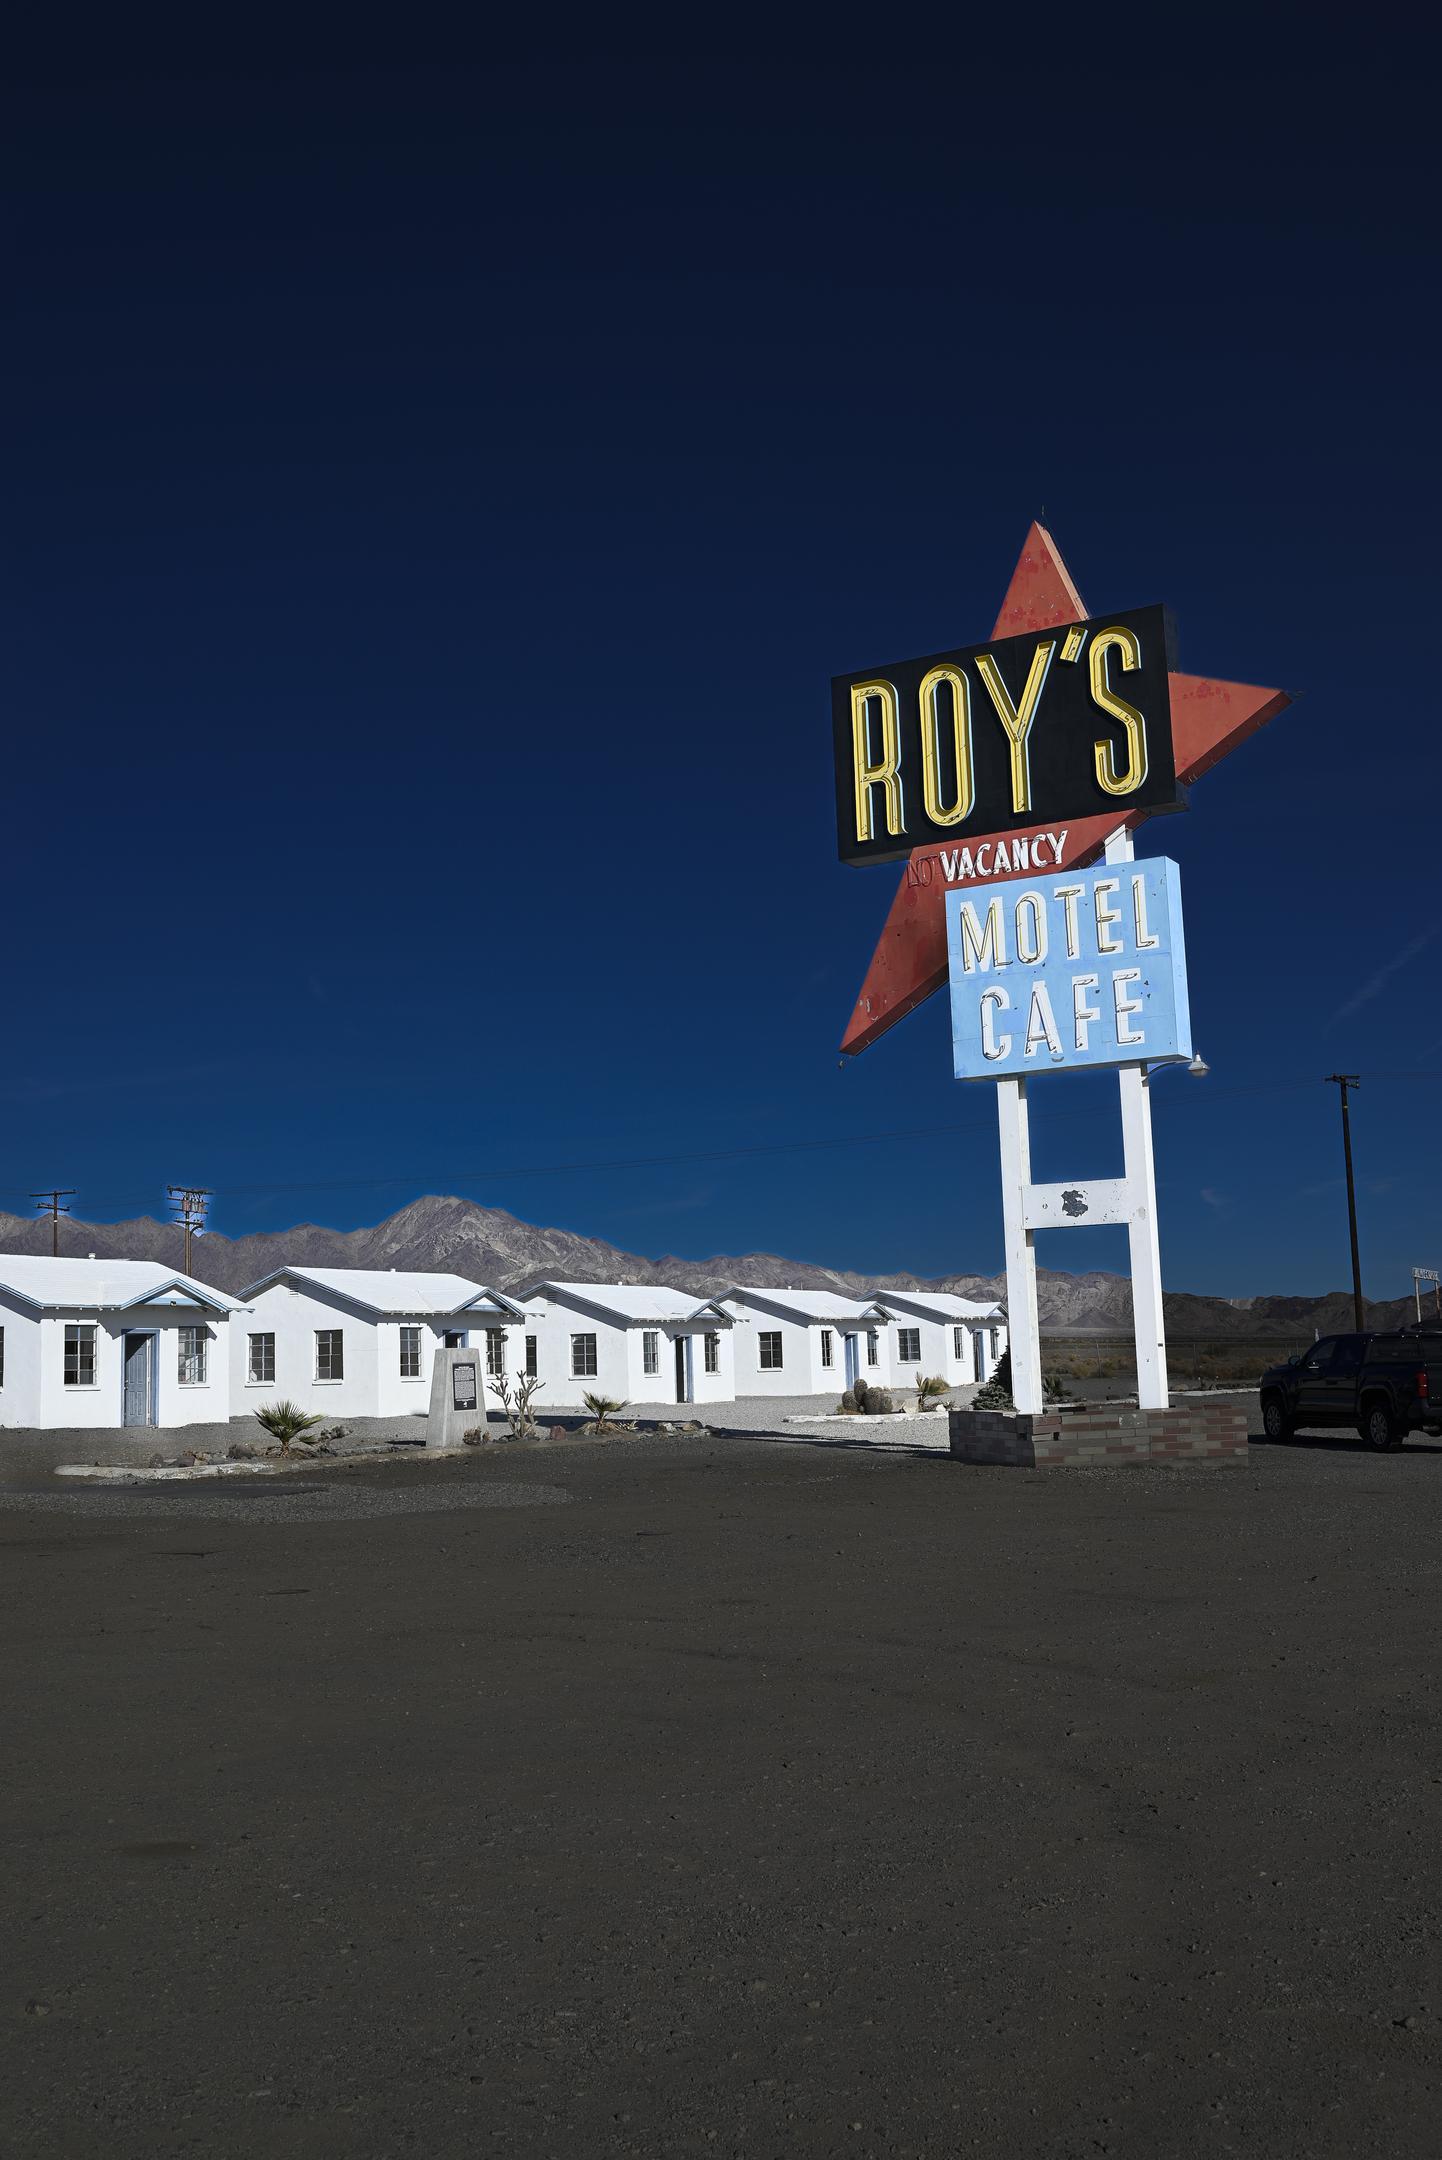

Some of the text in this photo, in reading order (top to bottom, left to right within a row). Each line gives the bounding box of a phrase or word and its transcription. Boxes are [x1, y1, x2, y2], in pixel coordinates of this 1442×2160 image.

[851, 626, 1148, 841] ROY'S
[940, 830, 1068, 882] VACANCY
[960, 874, 1160, 974] MOTEL
[980, 967, 1145, 1061] CAFE
